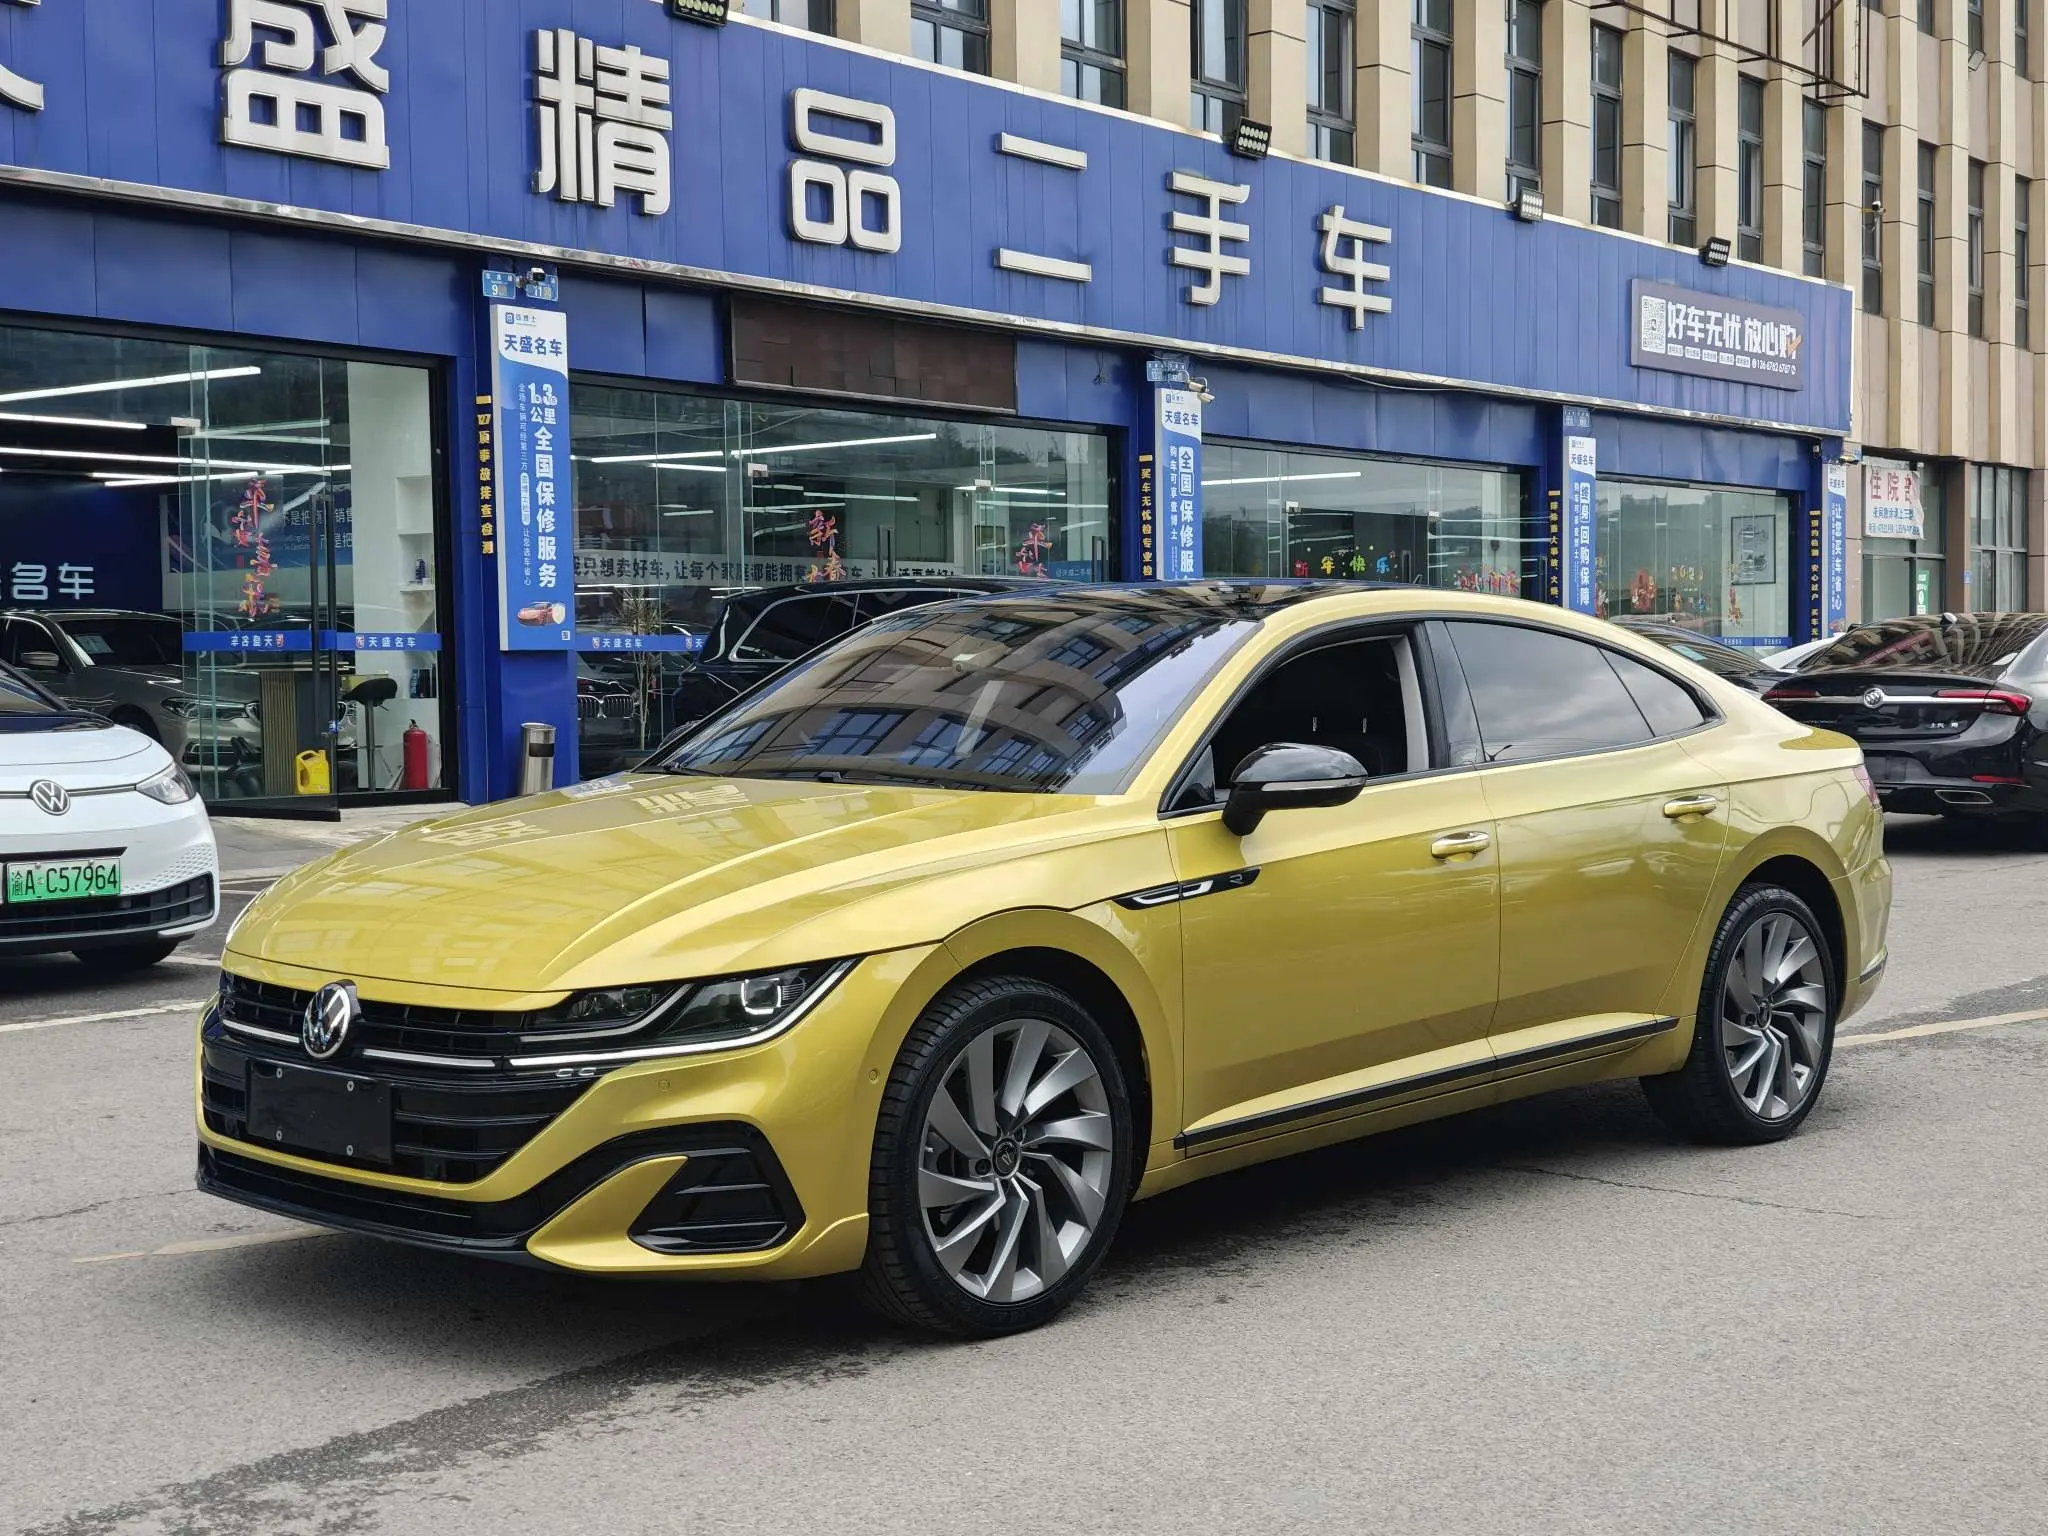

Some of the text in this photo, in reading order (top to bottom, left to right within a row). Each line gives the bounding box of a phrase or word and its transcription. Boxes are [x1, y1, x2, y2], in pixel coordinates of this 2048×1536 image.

[0, 0, 1393, 329] 盛精品二手车
[1667, 301, 1741, 350] 好车无忧
[504, 333, 563, 357] 天盛名车
[529, 406, 557, 425] 公里
[1165, 410, 1199, 427] 天盛名车
[533, 426, 558, 588] 全国保修服务
[1179, 449, 1194, 580] 全国保修服
[1293, 554, 1391, 577] 新年快乐
[0, 561, 96, 601] 名车
[368, 636, 417, 648] 天盛名车
[602, 638, 643, 648] 天盛名车
[46, 864, 118, 893] C57964
